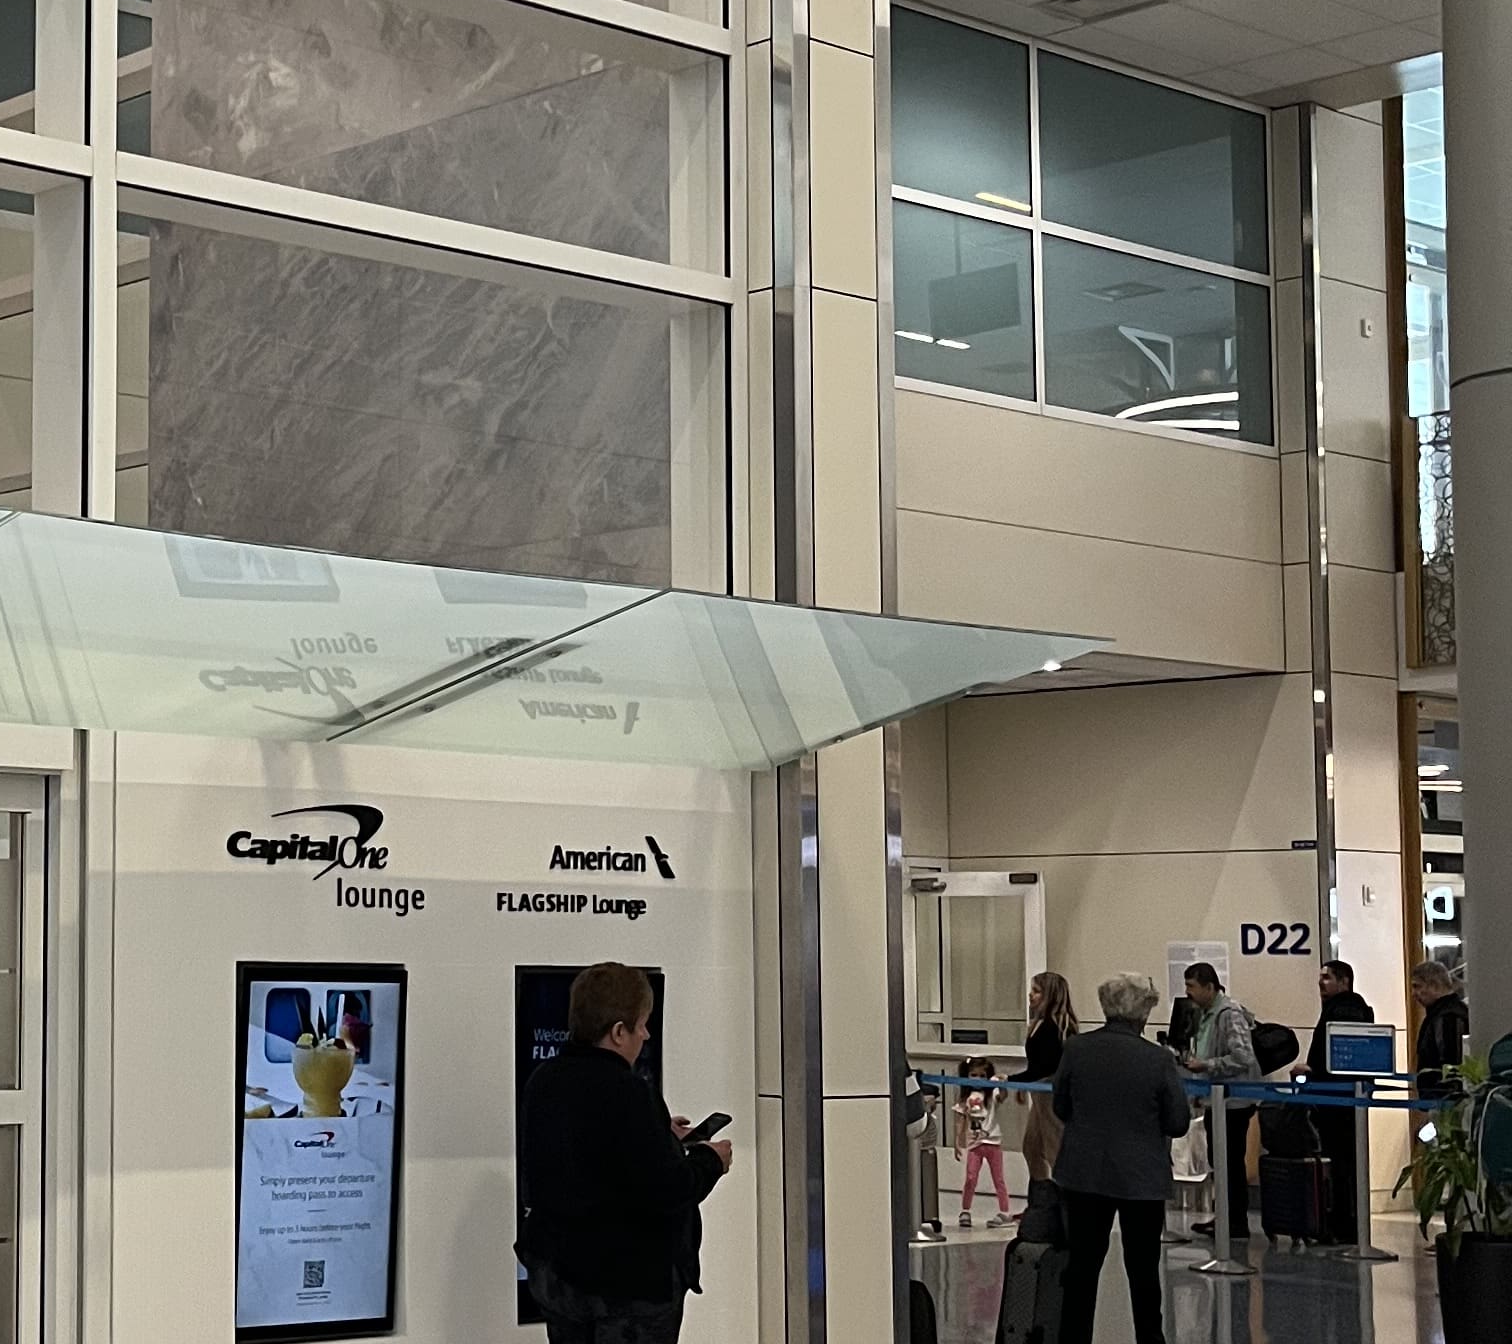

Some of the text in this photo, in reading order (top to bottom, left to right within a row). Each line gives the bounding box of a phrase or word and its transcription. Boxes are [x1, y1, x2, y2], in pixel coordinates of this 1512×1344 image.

[549, 845, 647, 873] American
[336, 877, 426, 917] lounge
[496, 892, 647, 921] FLAGSHIP Lounge
[1240, 922, 1312, 956] D22
